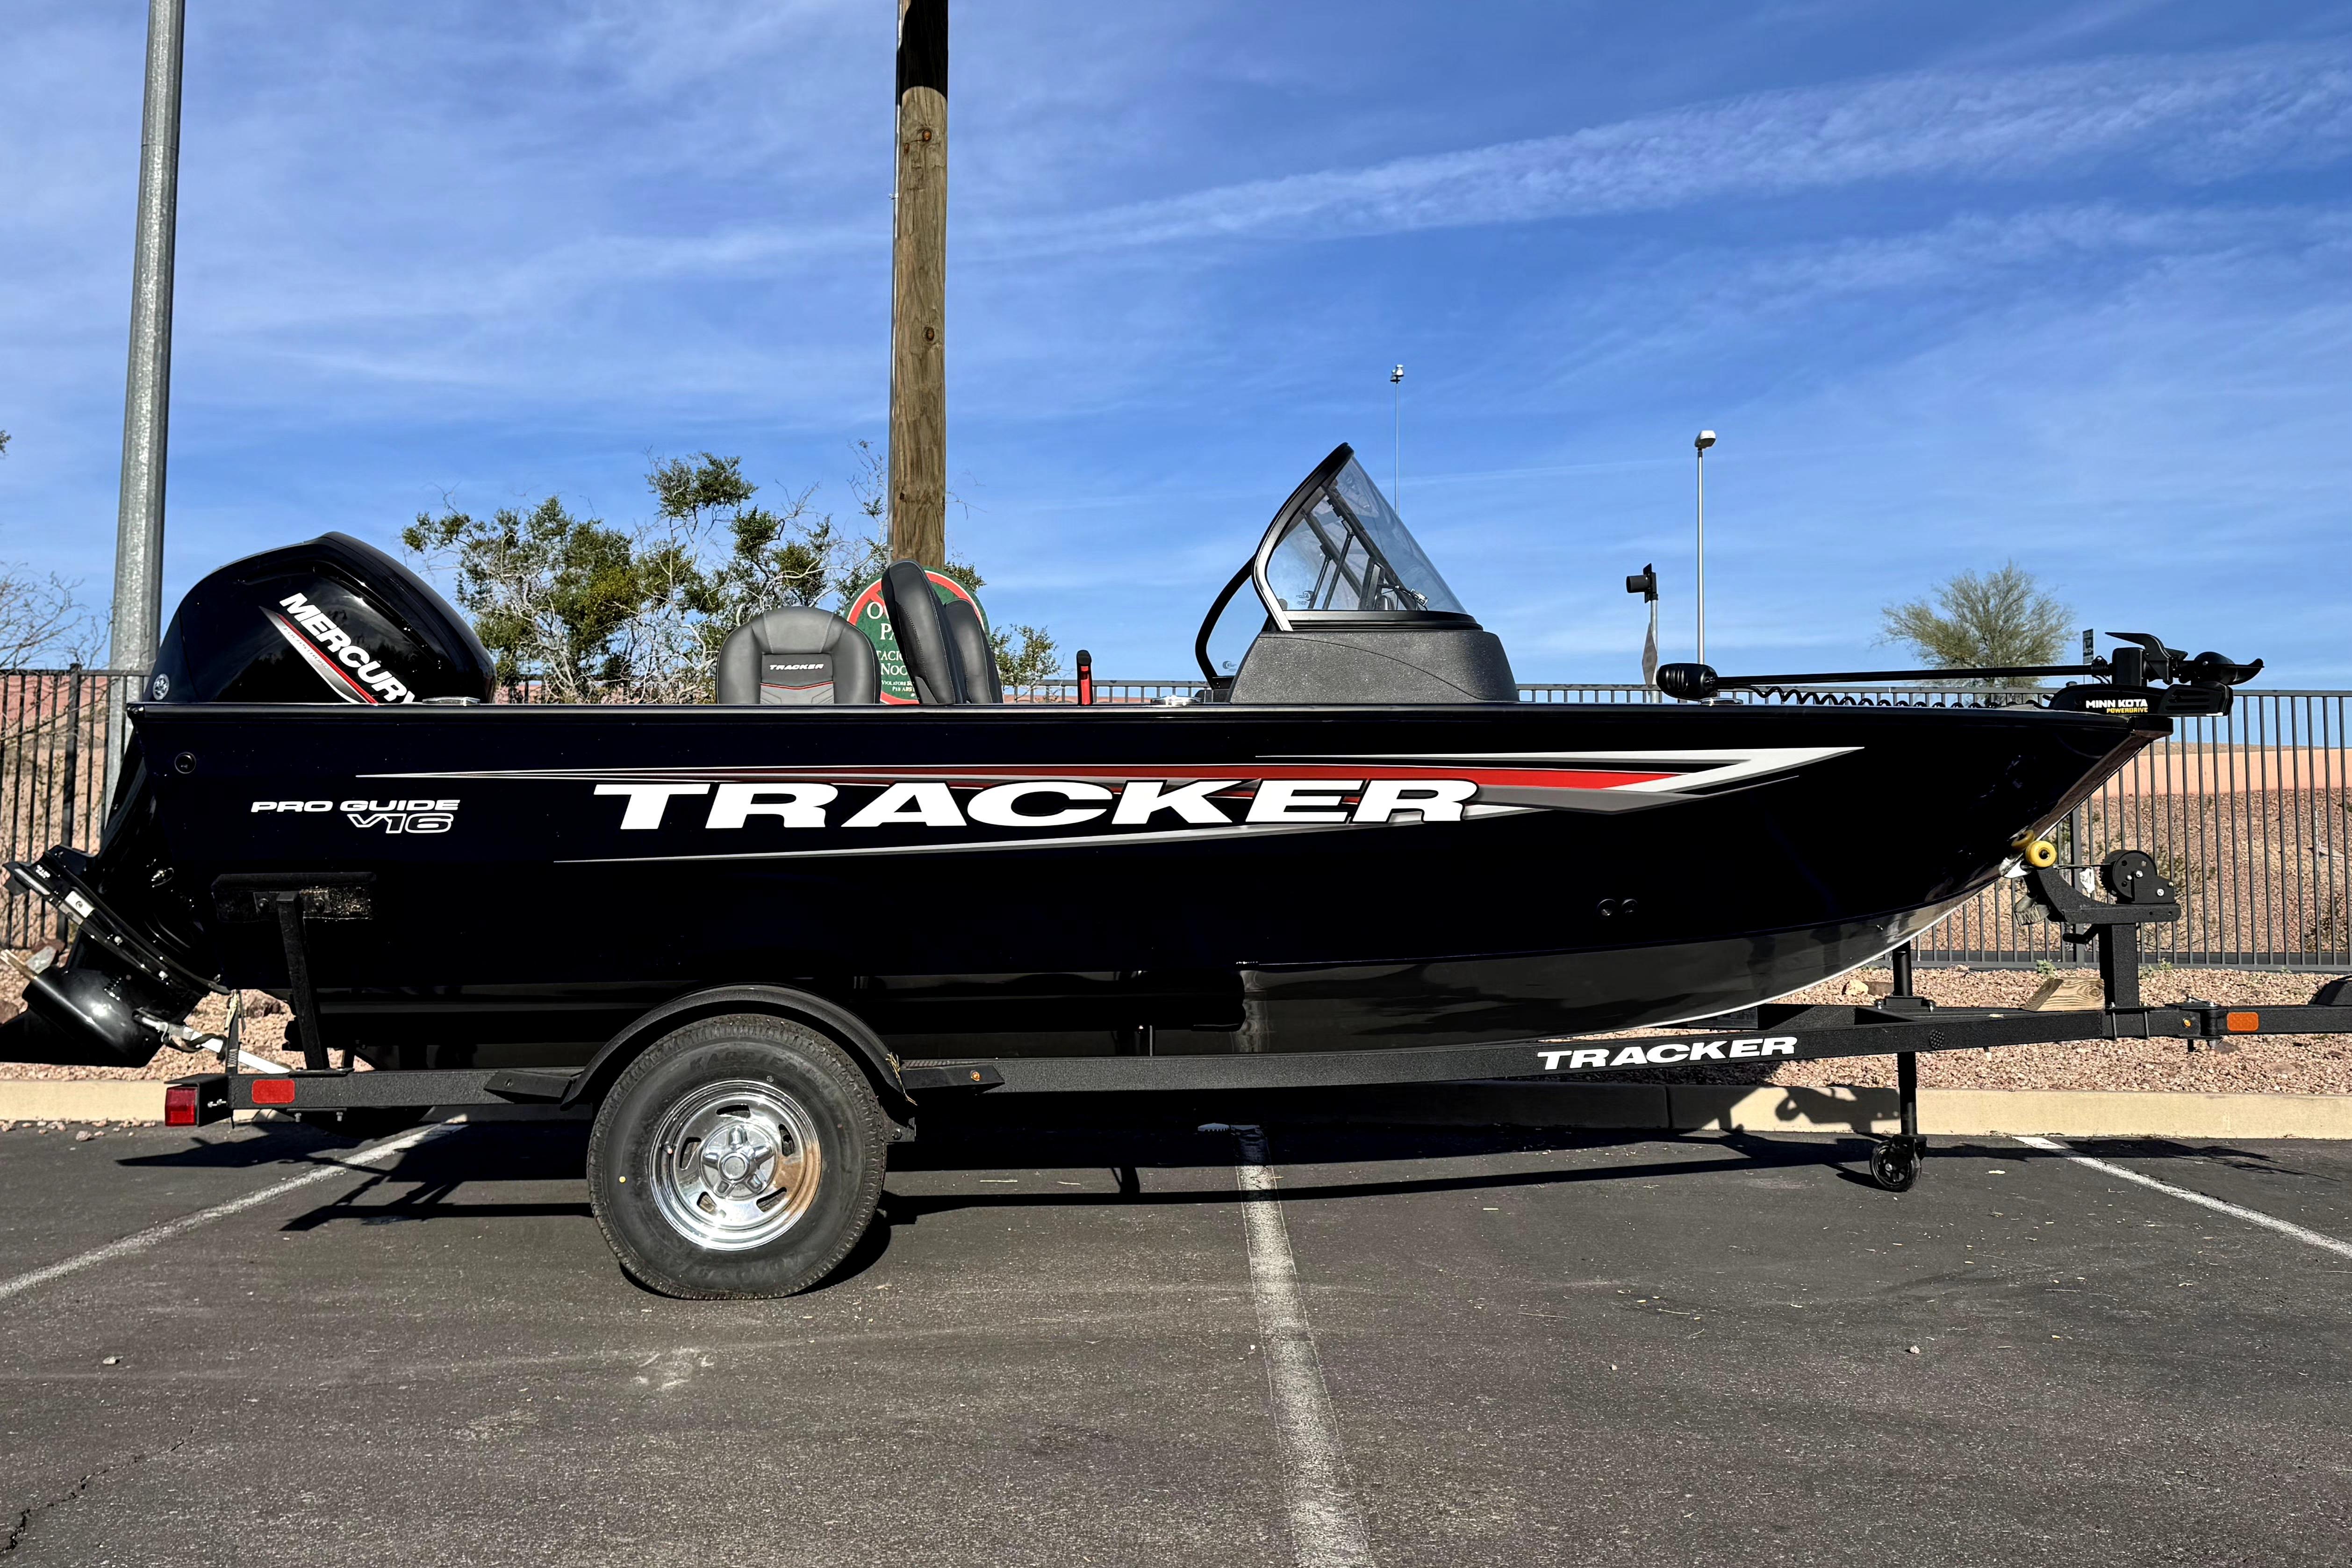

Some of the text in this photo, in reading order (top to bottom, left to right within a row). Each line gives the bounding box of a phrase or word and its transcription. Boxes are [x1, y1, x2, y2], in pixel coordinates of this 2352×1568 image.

[2086, 699, 2148, 709] MINN KOTA
[251, 800, 460, 812] PRO GUIDE
[594, 779, 1479, 830] TRACKER
[347, 813, 454, 834] V16
[1537, 1036, 1798, 1070] TRACKER
